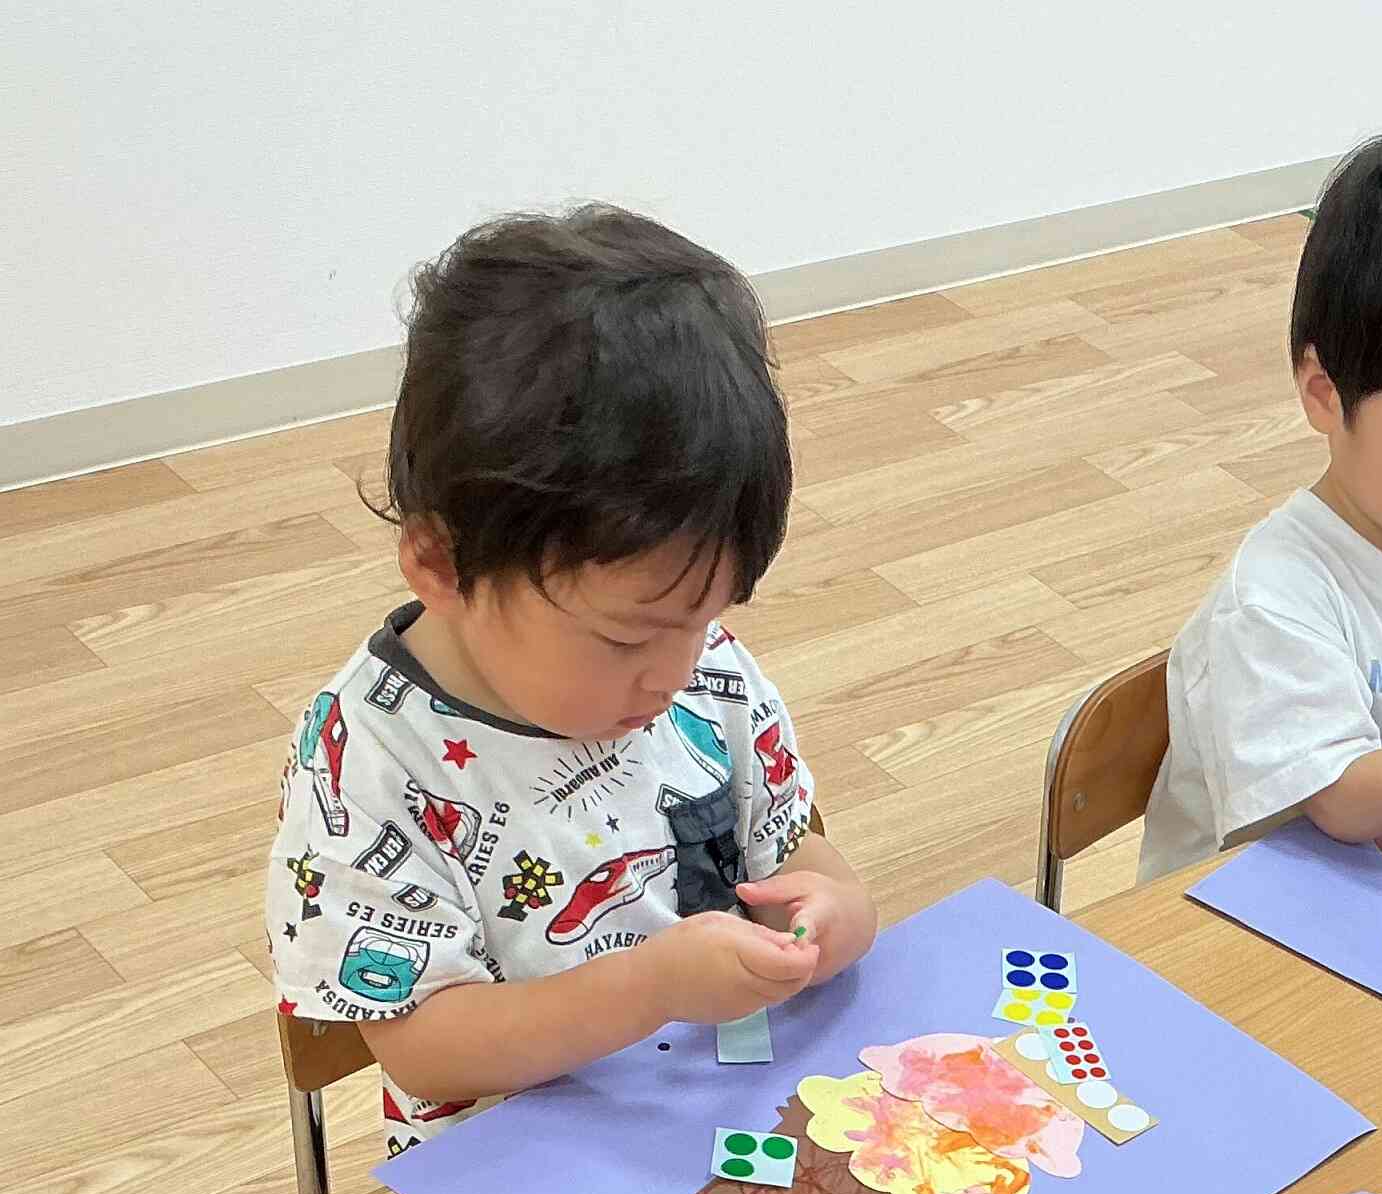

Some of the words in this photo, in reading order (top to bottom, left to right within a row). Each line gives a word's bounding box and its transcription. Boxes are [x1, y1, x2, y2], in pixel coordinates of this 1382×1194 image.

[489, 802, 510, 827] E6
[753, 803, 793, 842] SERI
[346, 901, 376, 922] E5
[380, 912, 459, 939] SERIES
